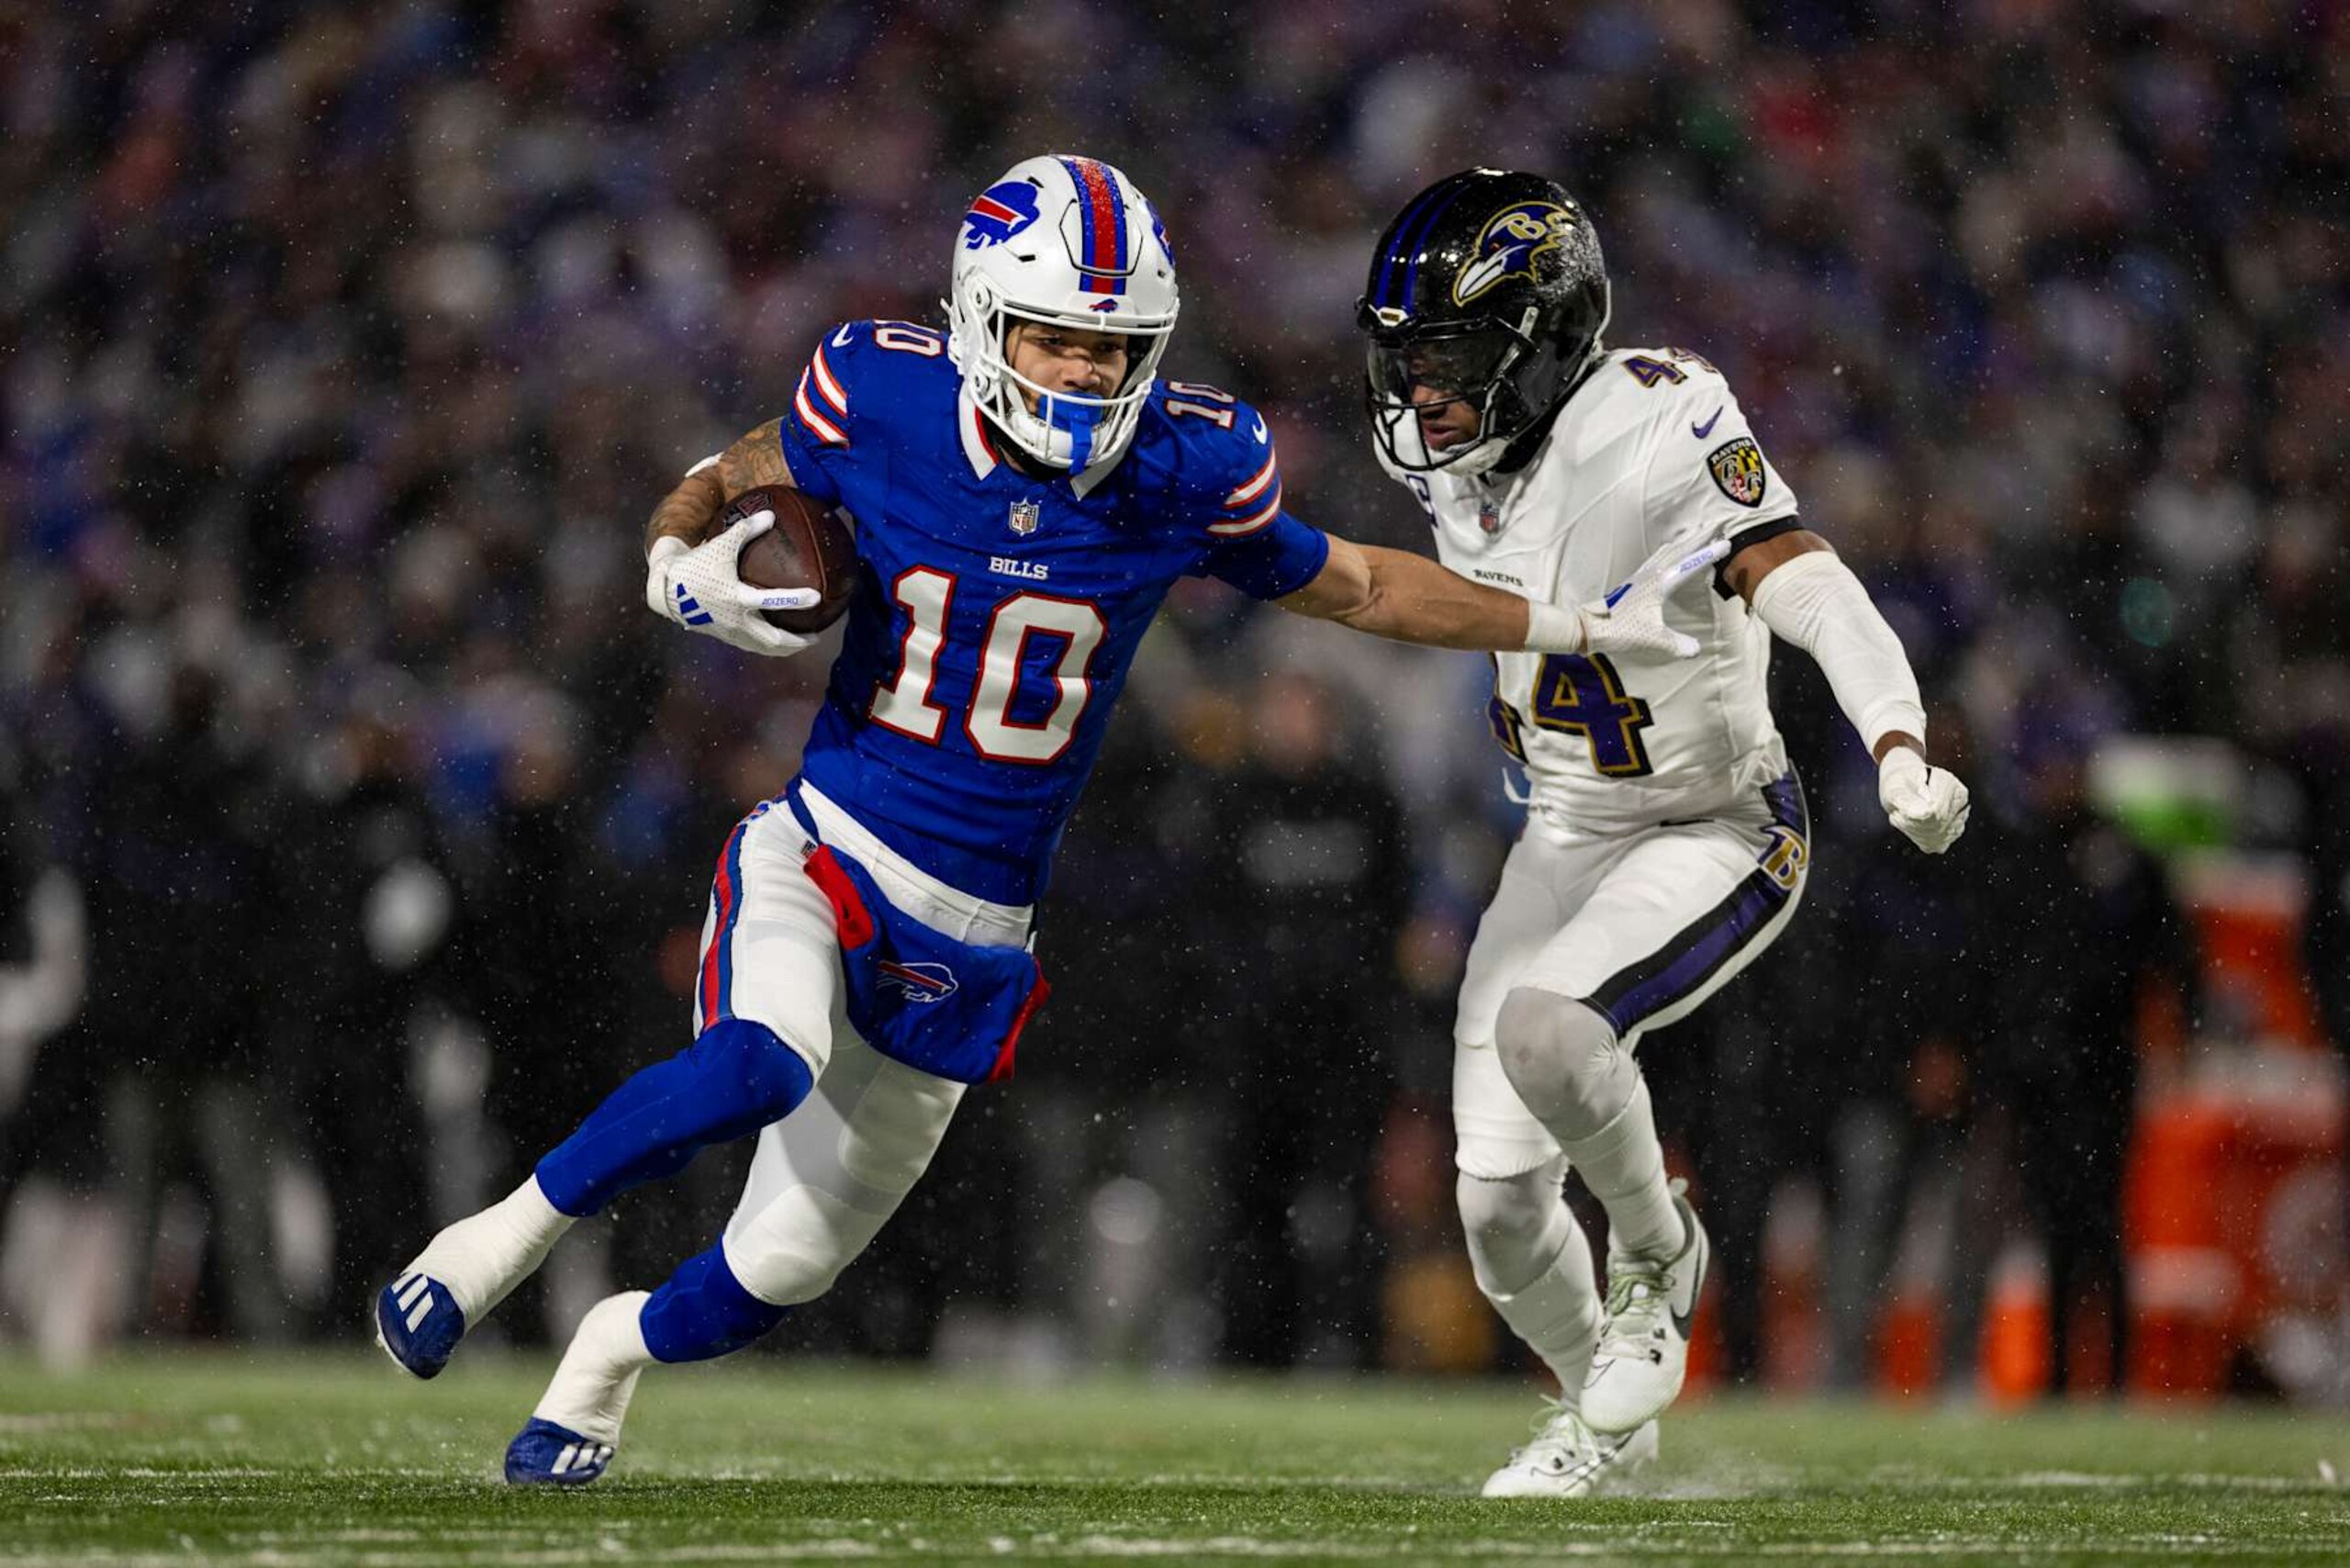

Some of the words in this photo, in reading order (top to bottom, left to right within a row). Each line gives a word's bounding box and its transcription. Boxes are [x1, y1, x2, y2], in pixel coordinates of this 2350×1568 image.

[1165, 380, 1235, 432] 10
[989, 556, 1048, 580] BILLS
[1472, 568, 1524, 588] RAVENS
[868, 564, 1108, 766] 10
